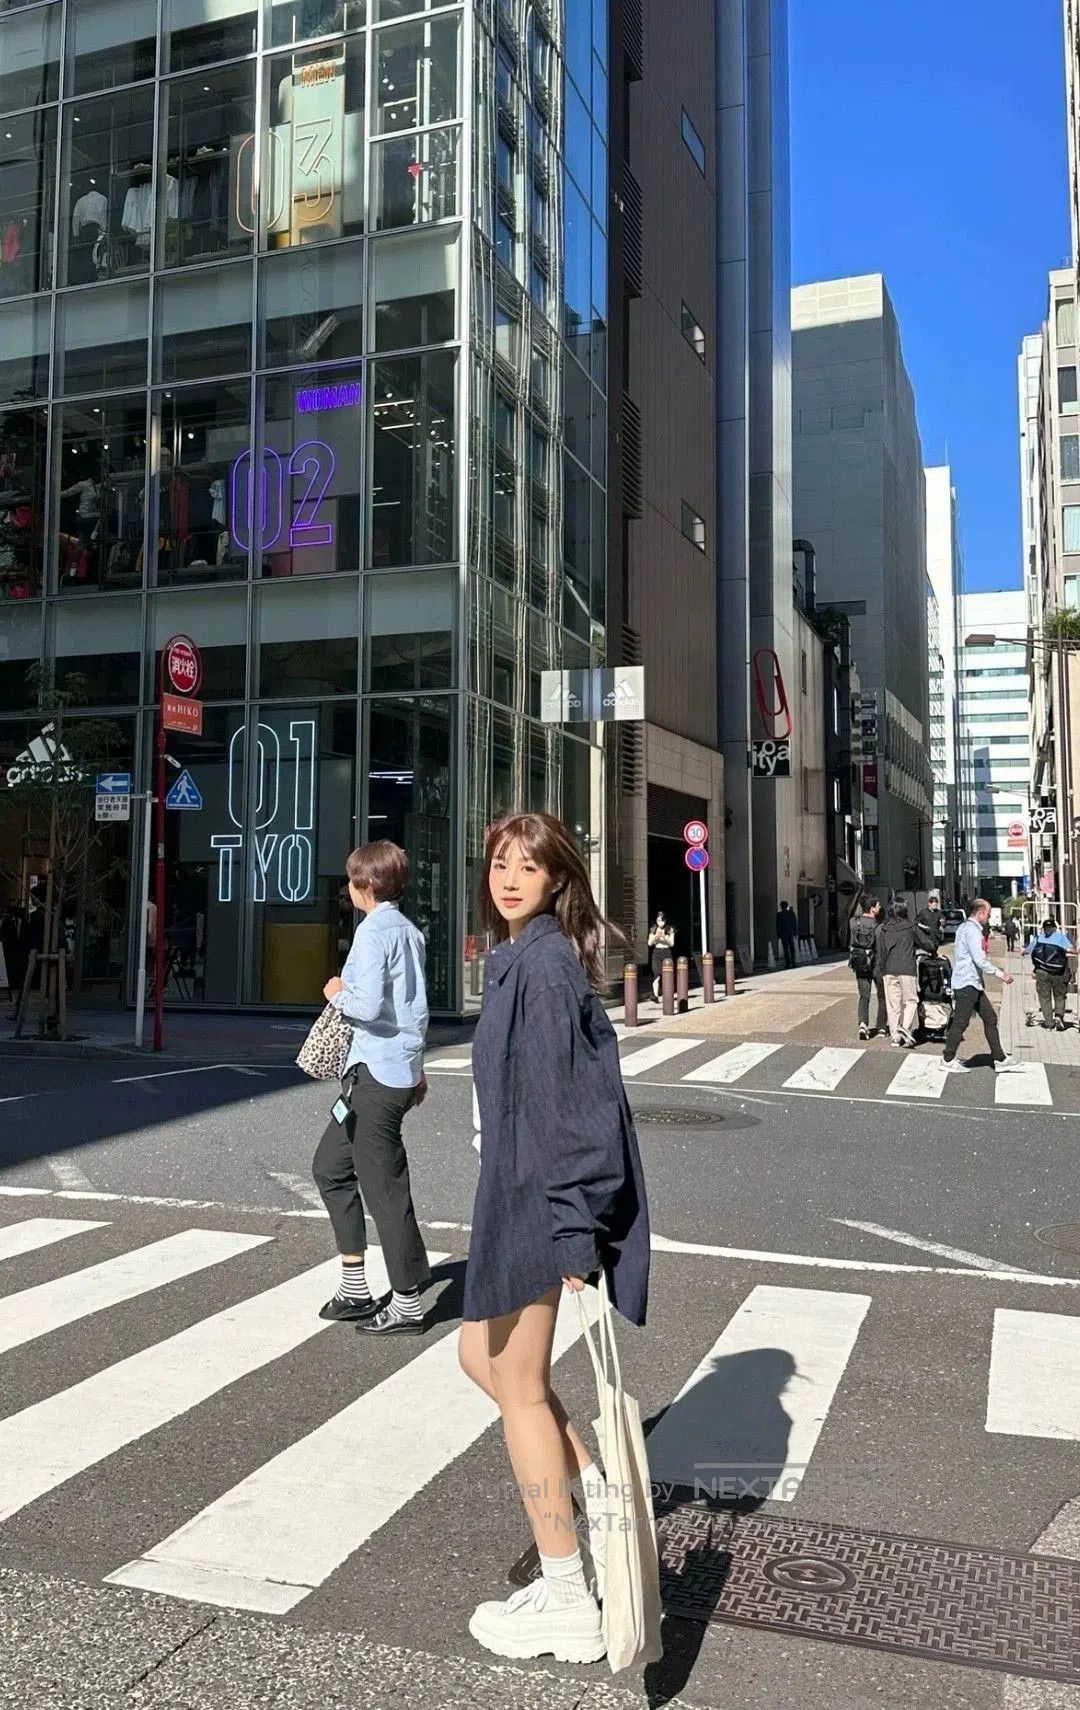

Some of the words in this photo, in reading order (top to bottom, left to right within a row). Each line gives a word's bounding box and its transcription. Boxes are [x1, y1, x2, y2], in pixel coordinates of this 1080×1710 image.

[301, 62, 336, 85] MEN
[236, 117, 334, 232] 03
[296, 383, 361, 413] WOMAN
[232, 440, 335, 550] 02
[171, 656, 195, 678] 消火栓
[228, 721, 315, 829] 01
[691, 828, 702, 838] 30
[211, 834, 312, 901] TYO
